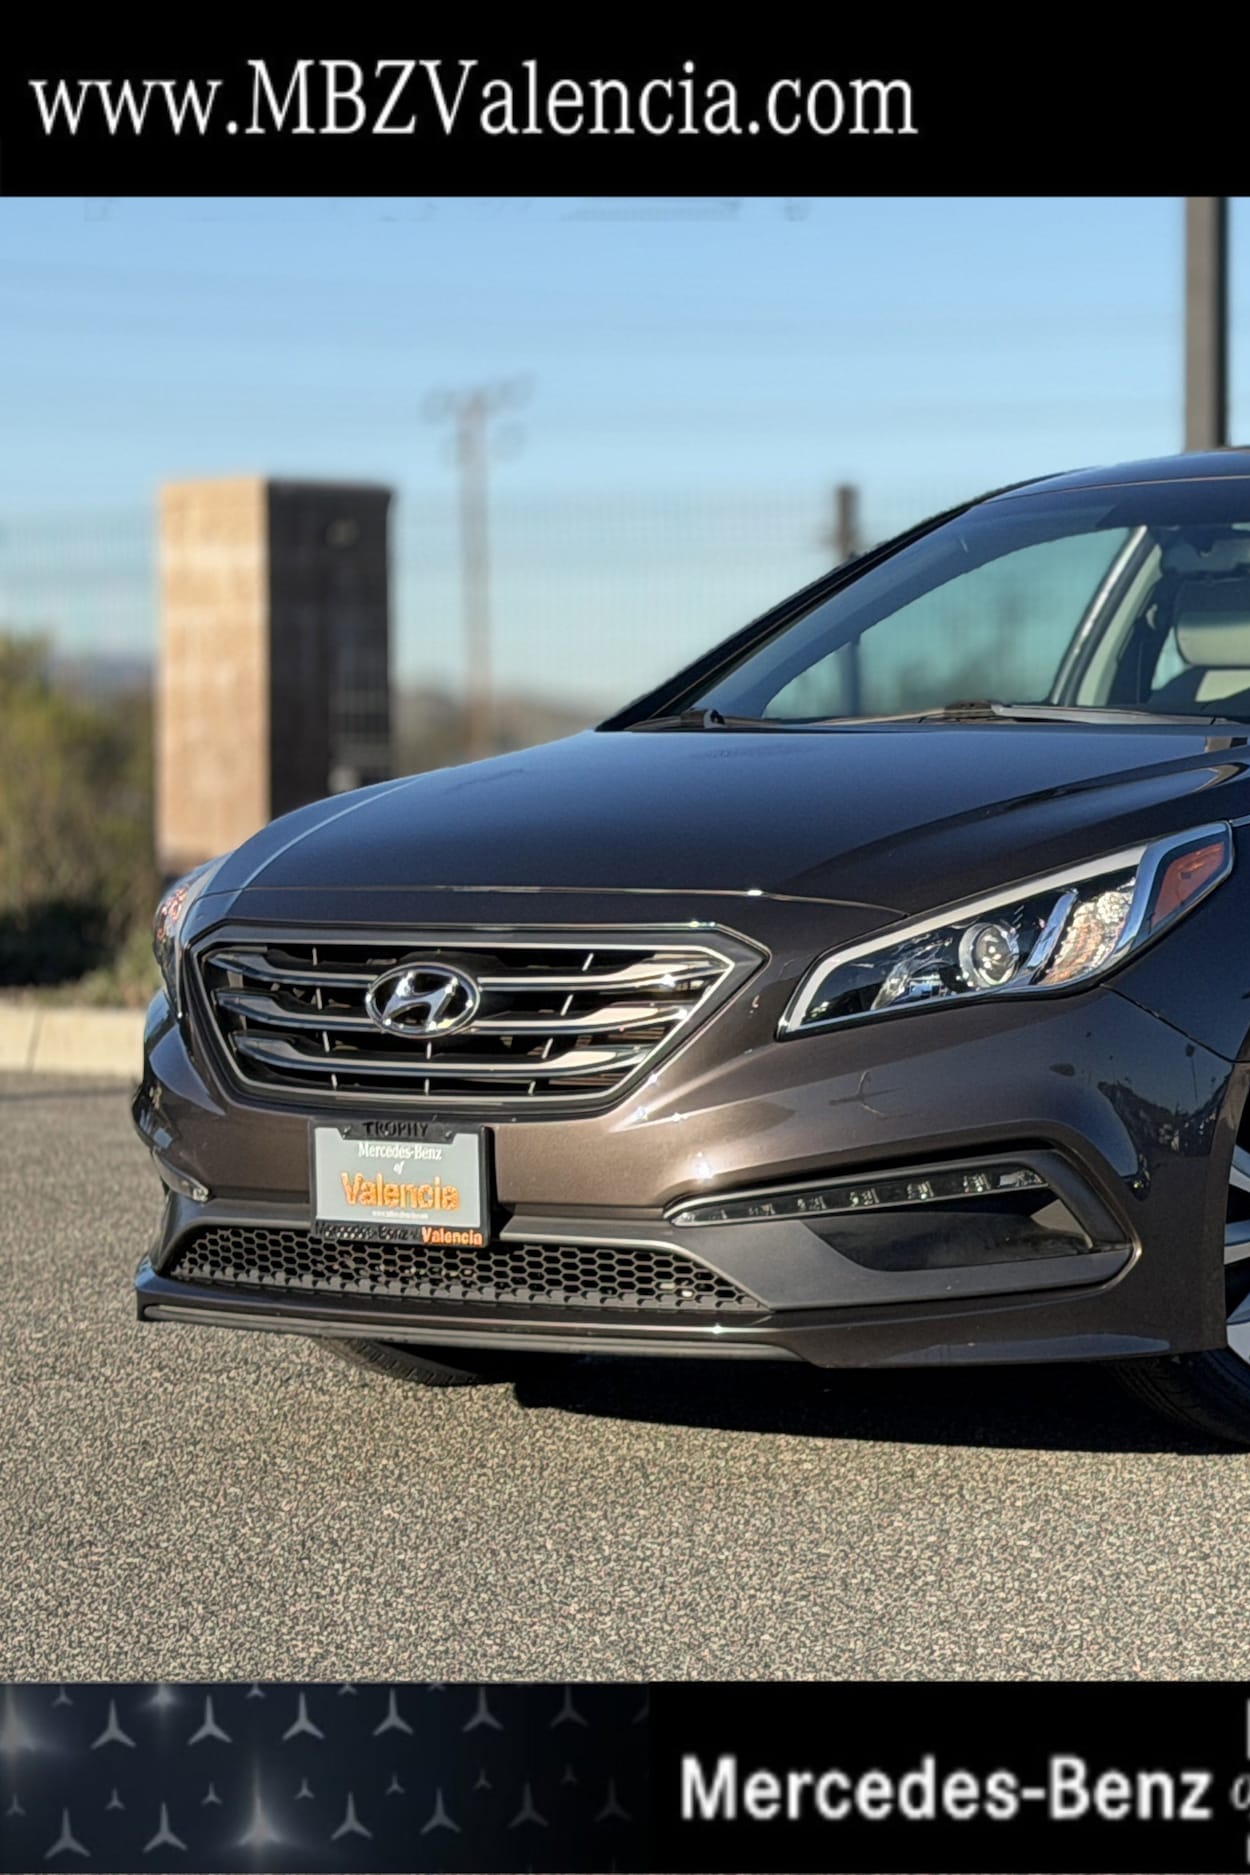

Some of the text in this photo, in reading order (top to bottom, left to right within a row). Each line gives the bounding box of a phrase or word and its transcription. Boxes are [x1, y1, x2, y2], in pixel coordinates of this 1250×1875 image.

[362, 1120, 429, 1138] TROPHY
[358, 1143, 442, 1161] Mercedes-Benz
[393, 1161, 405, 1175] of
[340, 1172, 460, 1211] Valencia
[421, 1226, 484, 1247] Valencia
